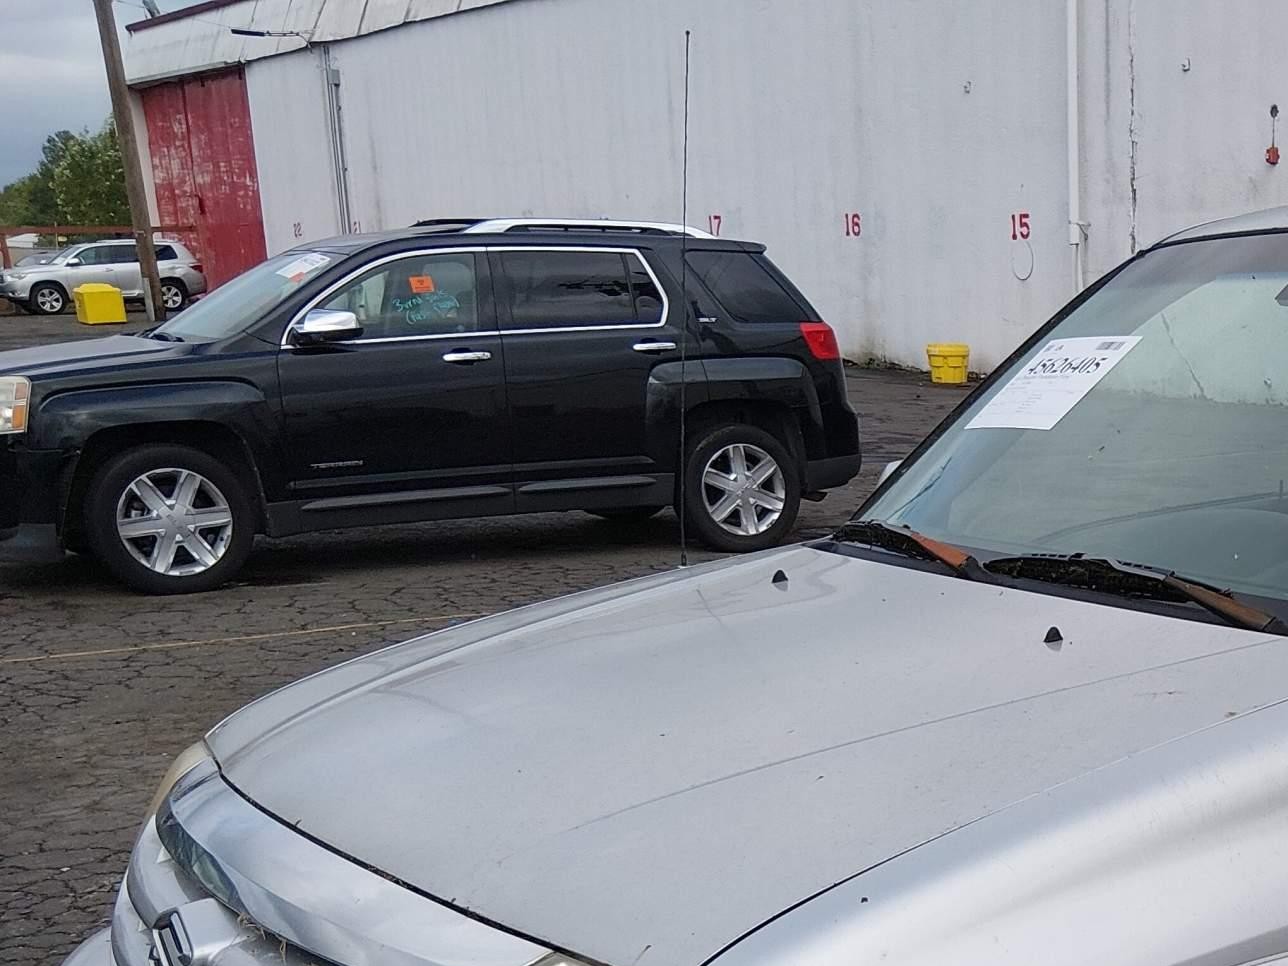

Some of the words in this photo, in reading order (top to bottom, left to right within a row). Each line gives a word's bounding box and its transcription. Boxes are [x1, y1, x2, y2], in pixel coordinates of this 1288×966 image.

[708, 215, 721, 237] 17
[844, 213, 862, 236] 16
[1011, 213, 1030, 241] 15
[1027, 357, 1108, 375] 45626405
